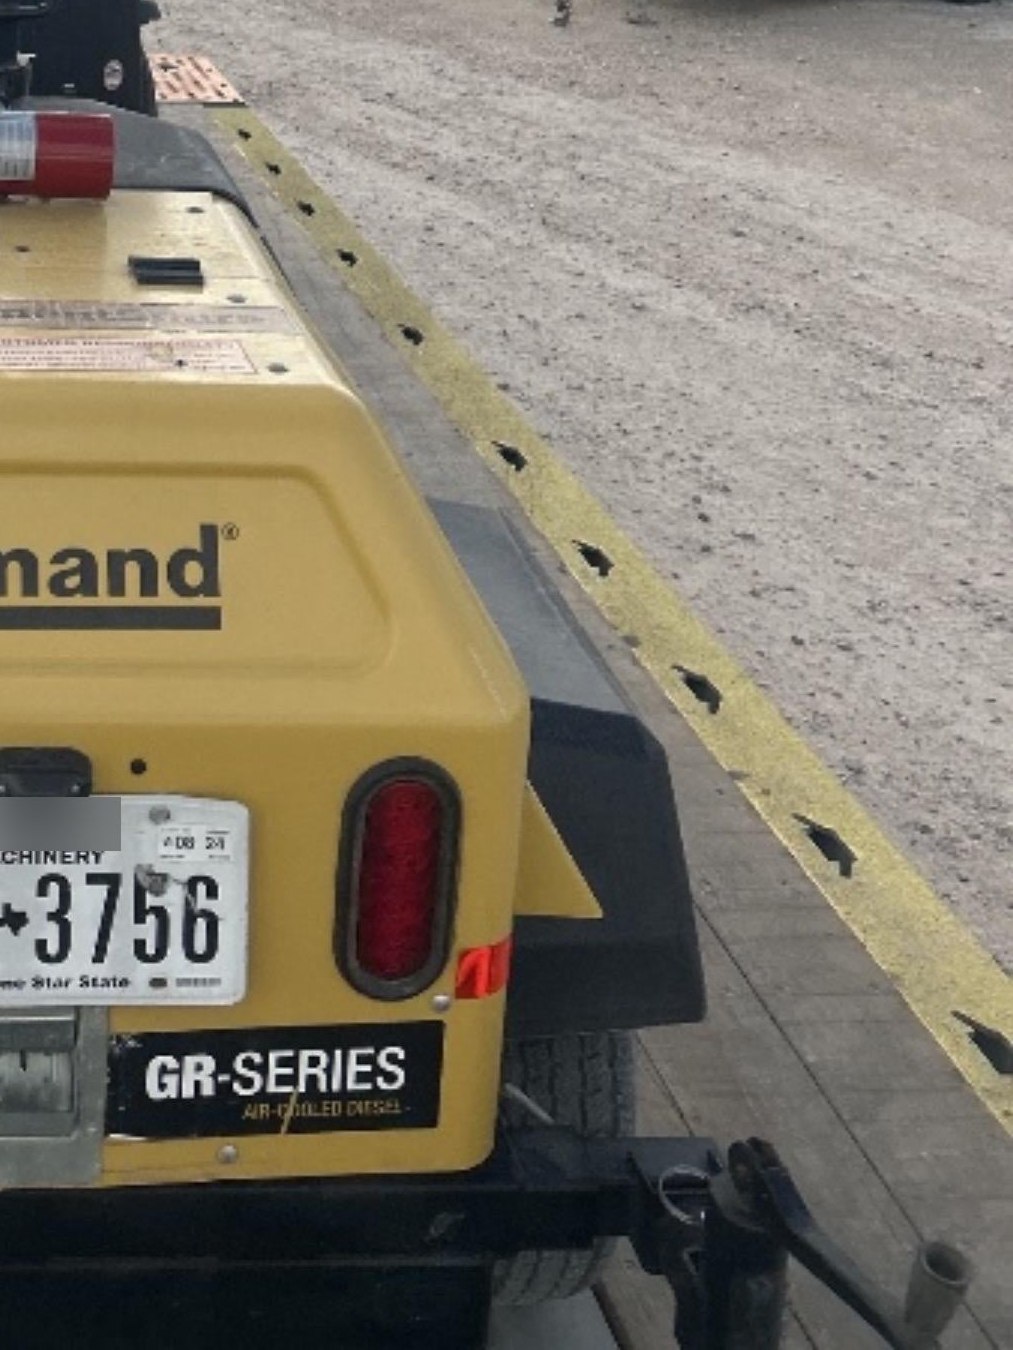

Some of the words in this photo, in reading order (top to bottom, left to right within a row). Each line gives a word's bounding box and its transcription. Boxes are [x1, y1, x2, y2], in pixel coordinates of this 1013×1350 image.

[34, 872, 220, 965] 3756
[31, 975, 71, 990] Star
[78, 974, 131, 989] State
[145, 1046, 406, 1100] GR-SERIES
